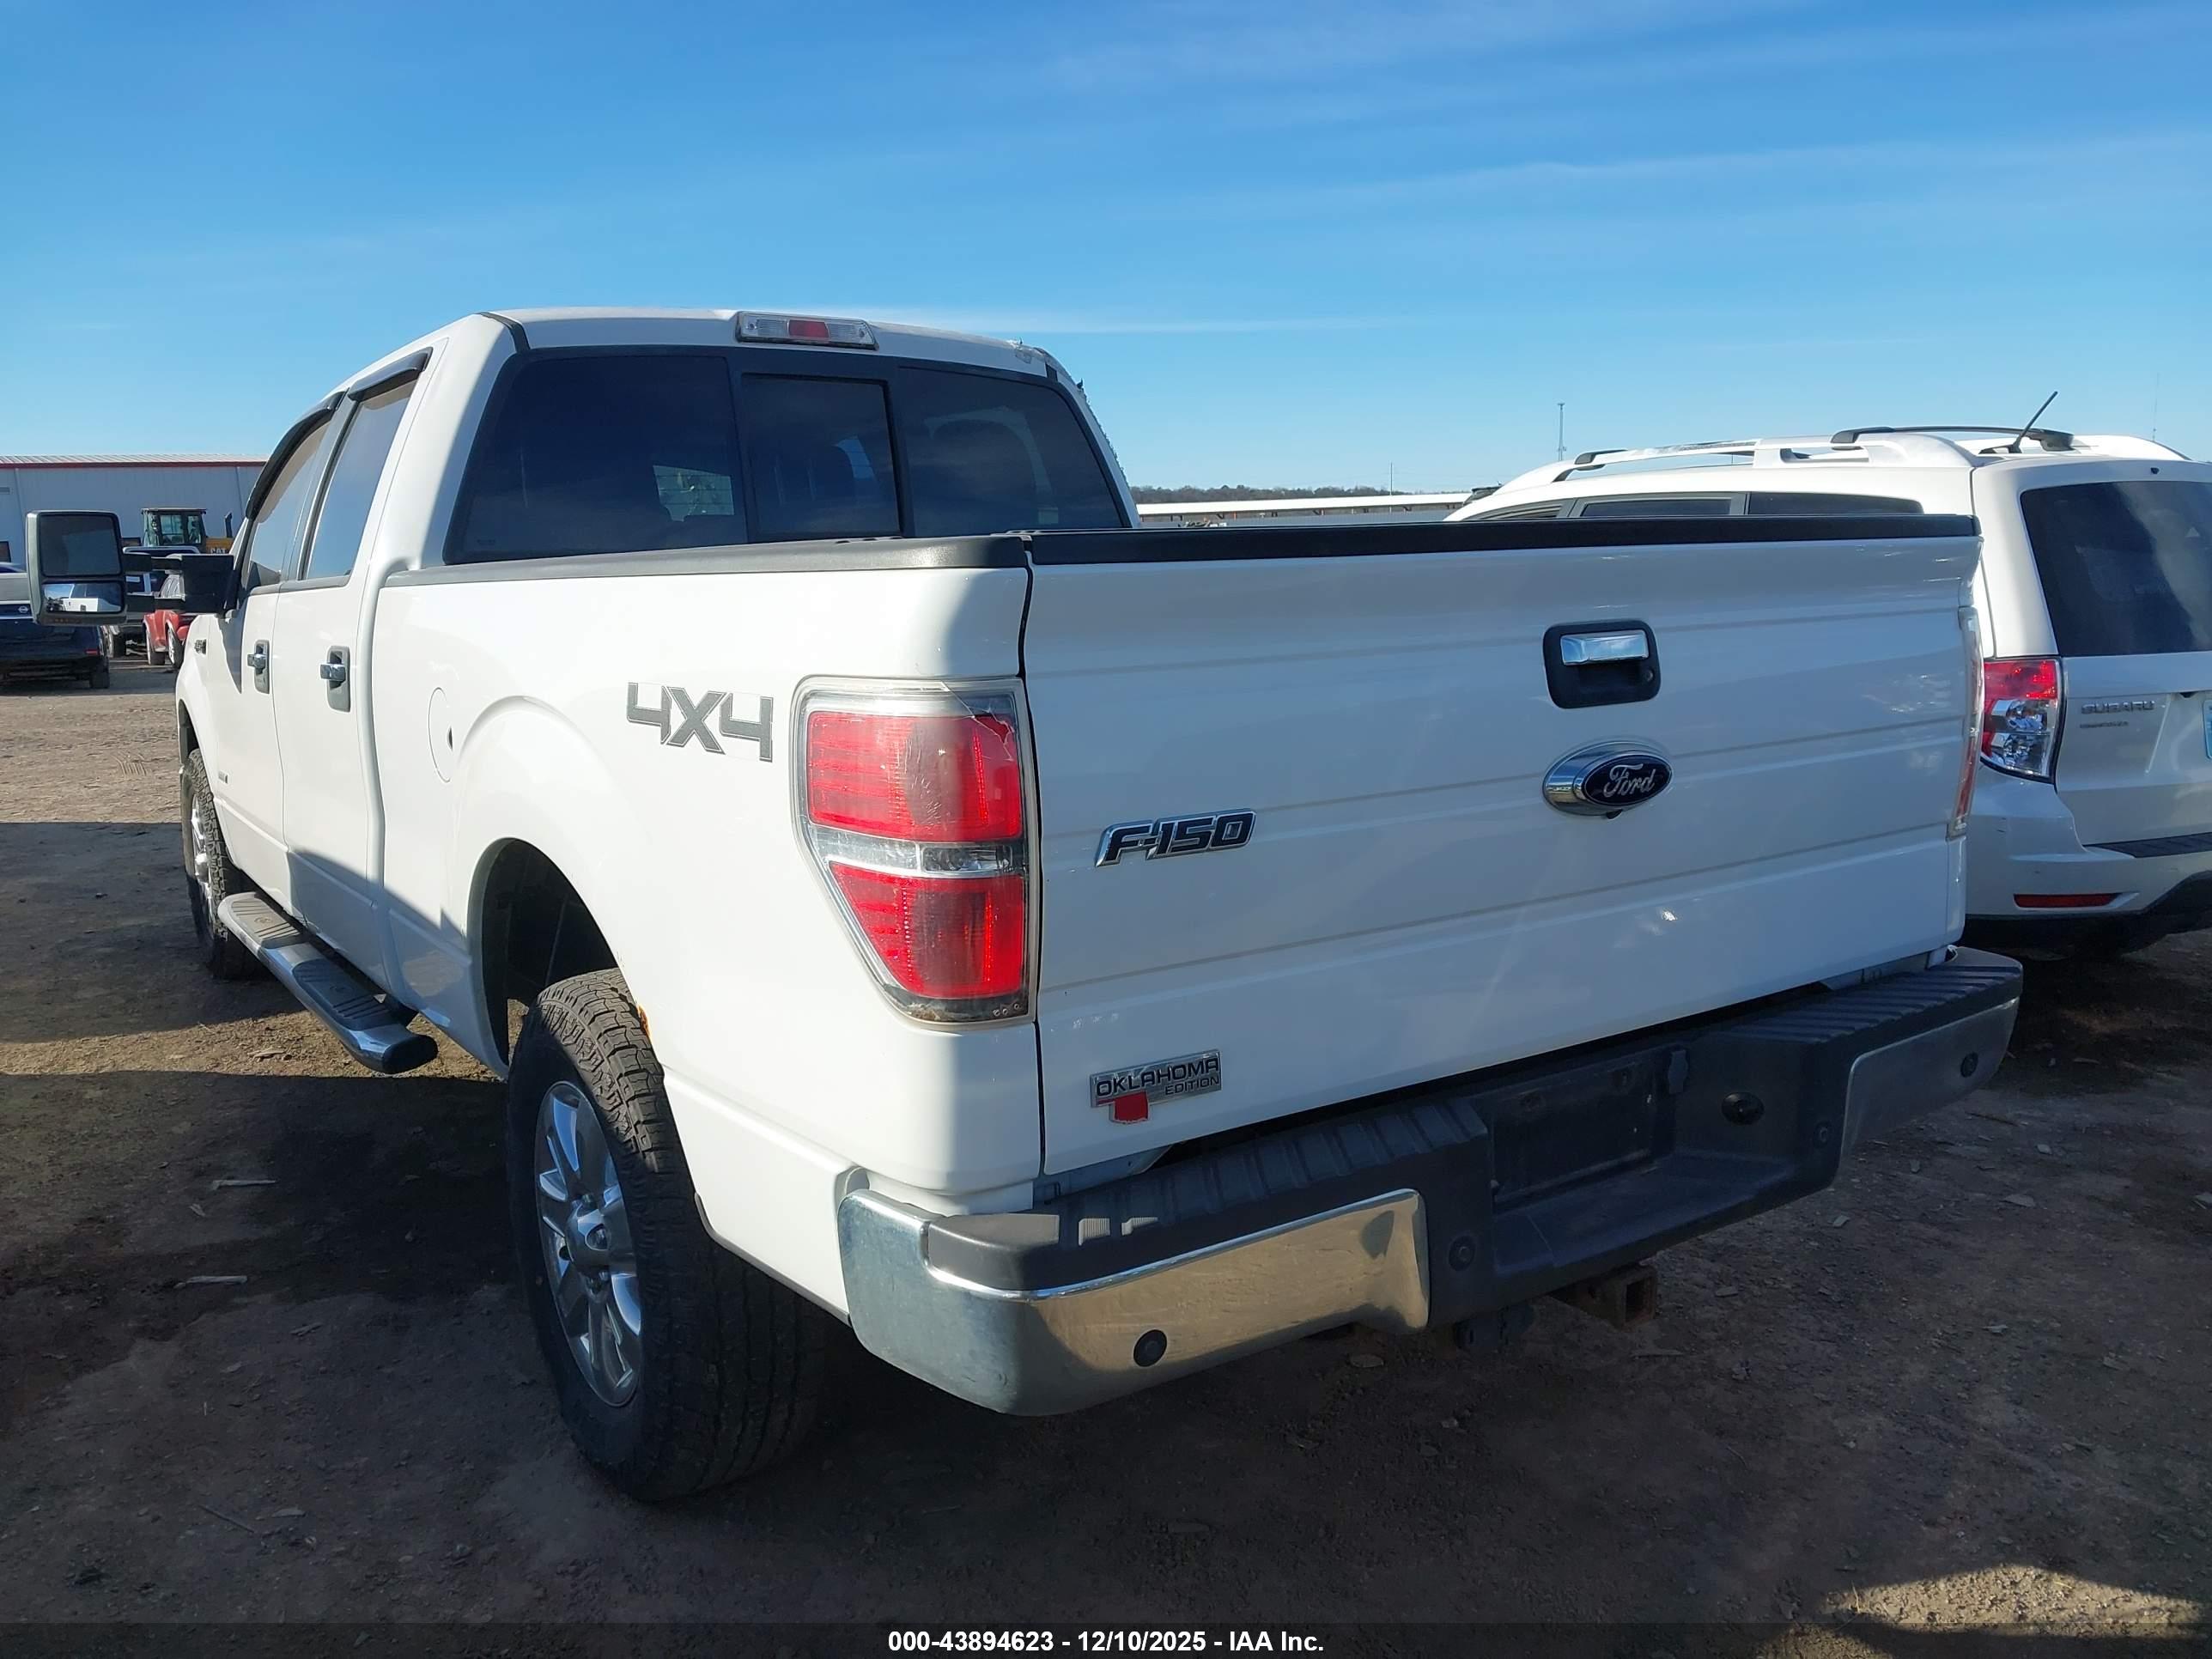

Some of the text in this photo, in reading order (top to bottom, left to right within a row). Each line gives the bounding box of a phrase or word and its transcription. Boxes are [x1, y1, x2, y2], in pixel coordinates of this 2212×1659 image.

[2081, 701, 2155, 714] SUBARU
[1602, 763, 1656, 798] Ford
[1096, 808, 1256, 867] F-150
[1096, 1057, 1219, 1097] OKLAHOMA
[1164, 1075, 1220, 1096] EDITION
